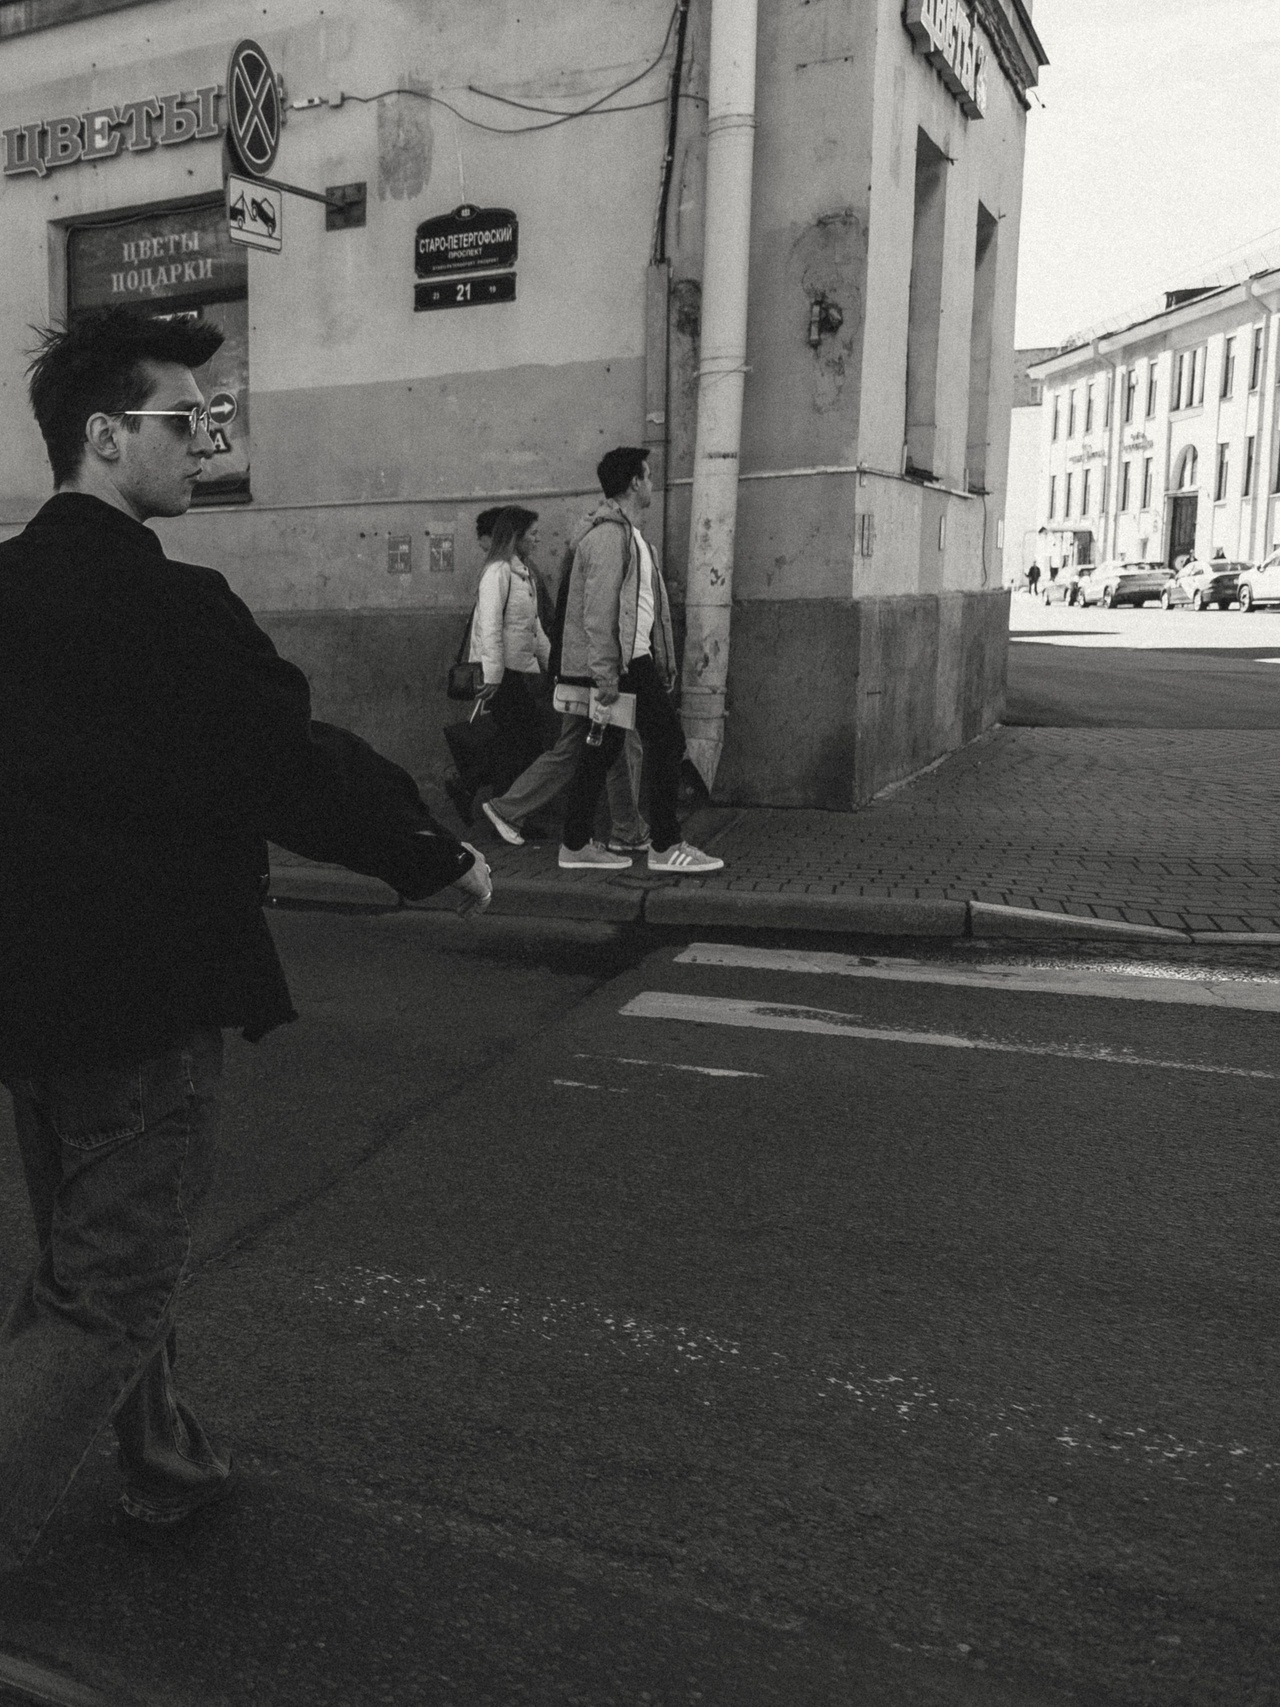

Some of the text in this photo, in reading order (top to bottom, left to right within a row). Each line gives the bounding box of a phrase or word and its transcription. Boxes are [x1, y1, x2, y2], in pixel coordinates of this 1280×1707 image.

[2, 84, 219, 177] ЦВЕТЫ
[122, 231, 200, 266] ЦВЕТЫ
[419, 224, 513, 254] СТАРО-ПЕТЕРГОФСКИЙ
[448, 247, 482, 259] ПРОСПЕКТ
[111, 258, 213, 293] ПОДАРКИ
[456, 283, 471, 301] 21
